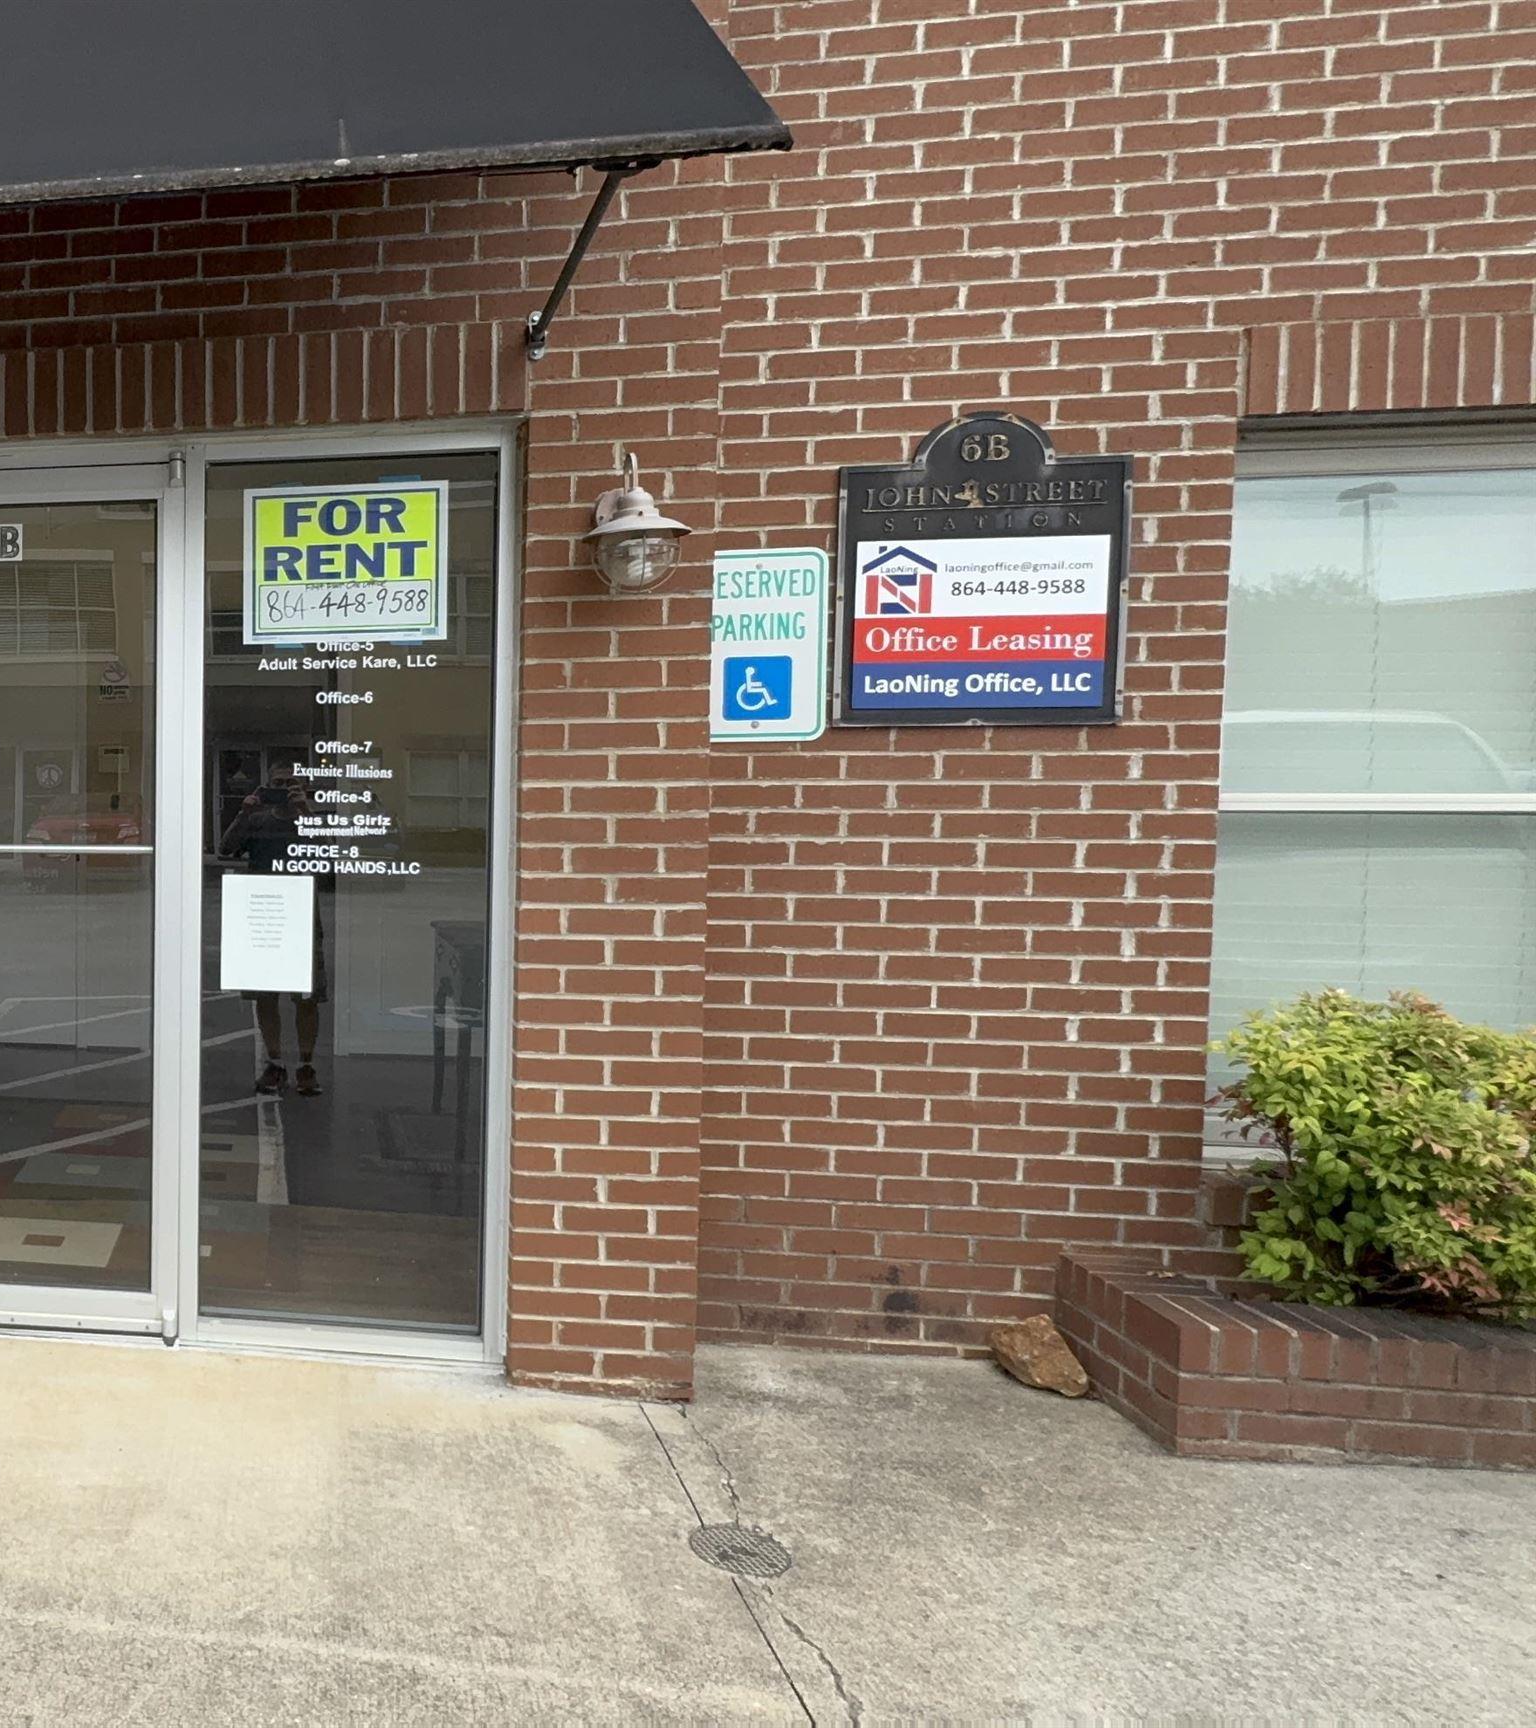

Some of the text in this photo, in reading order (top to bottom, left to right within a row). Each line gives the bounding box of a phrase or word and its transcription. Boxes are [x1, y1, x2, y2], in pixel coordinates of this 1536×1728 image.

[960, 434, 1010, 463] 6B
[865, 479, 1108, 510] JOHN STREET
[284, 497, 406, 537] FOR
[884, 512, 1082, 532] STATION
[264, 541, 428, 581] RENT
[880, 566, 919, 574] LaoNing
[944, 559, 1093, 574] laoningoffice@gmail.com
[717, 569, 816, 599] ESERVED
[951, 579, 1086, 597] 864-448-9588
[267, 588, 429, 622] 864-448-9588
[711, 612, 806, 642] PARKING
[865, 625, 1093, 658] Office Leasing
[258, 655, 437, 671] Adult Service Kare, LLC
[865, 673, 1091, 697] LaoNing Office, LLC
[315, 692, 373, 704] Office-6
[315, 742, 372, 754] Office-7
[293, 763, 393, 782] Exquisite Illusions
[314, 791, 372, 803] Office-8
[293, 815, 322, 826] Jus
[327, 814, 348, 826] Us
[287, 845, 339, 857] OFFICE
[287, 861, 330, 873] GOOD
